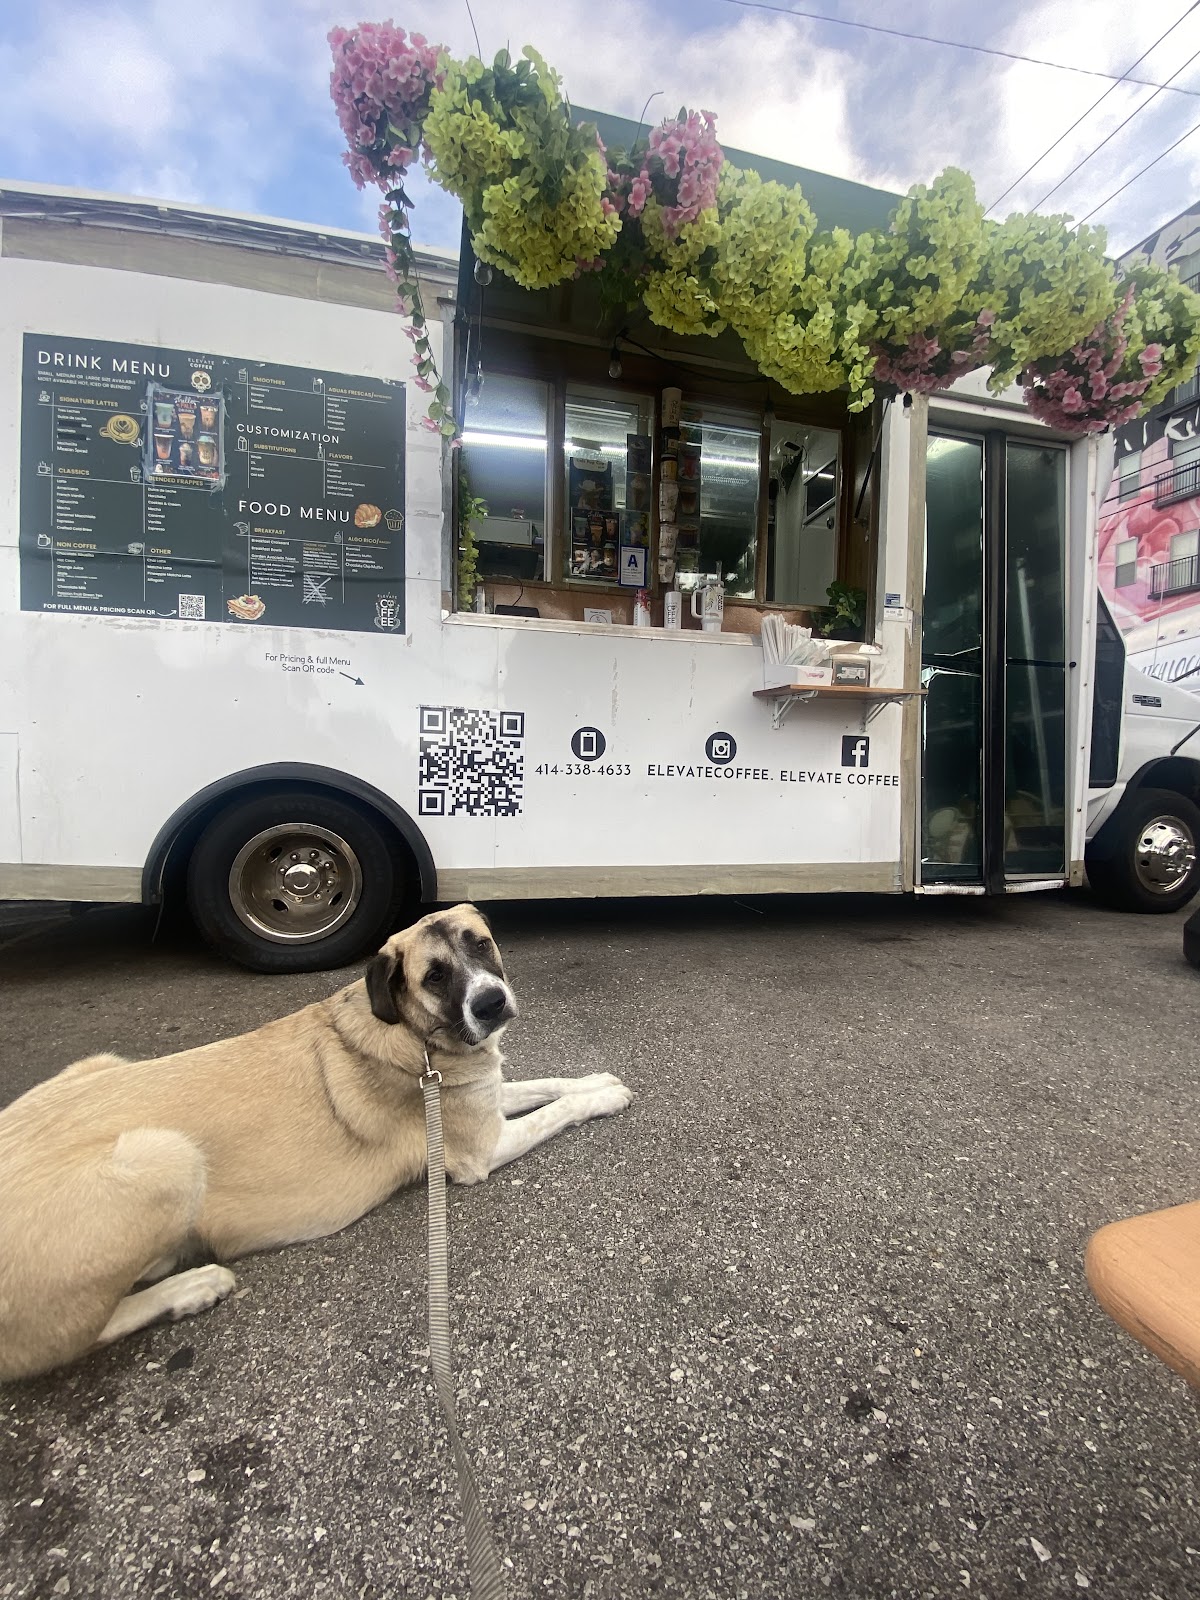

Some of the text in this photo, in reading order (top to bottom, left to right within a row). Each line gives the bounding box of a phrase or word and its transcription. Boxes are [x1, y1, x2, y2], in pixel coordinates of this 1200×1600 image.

[38, 350, 170, 378] DRINK MENU
[188, 357, 215, 366] ELEVATE
[60, 396, 118, 407] SIGNATURE LATTES
[236, 424, 339, 444] CUSTOMIZATION
[254, 443, 296, 453] SUBSTITUTIONS
[238, 500, 350, 522] FOOD MENU
[628, 554, 638, 568] A
[265, 653, 278, 661] For
[280, 654, 305, 664] Pricing
[316, 656, 328, 664] full
[329, 657, 351, 665] Menu
[282, 664, 300, 672] Scan
[534, 764, 632, 776] 414-338-4633
[648, 764, 774, 781] ELEVATECOFFEE.
[780, 770, 899, 786] ELEVATE COFFEE
